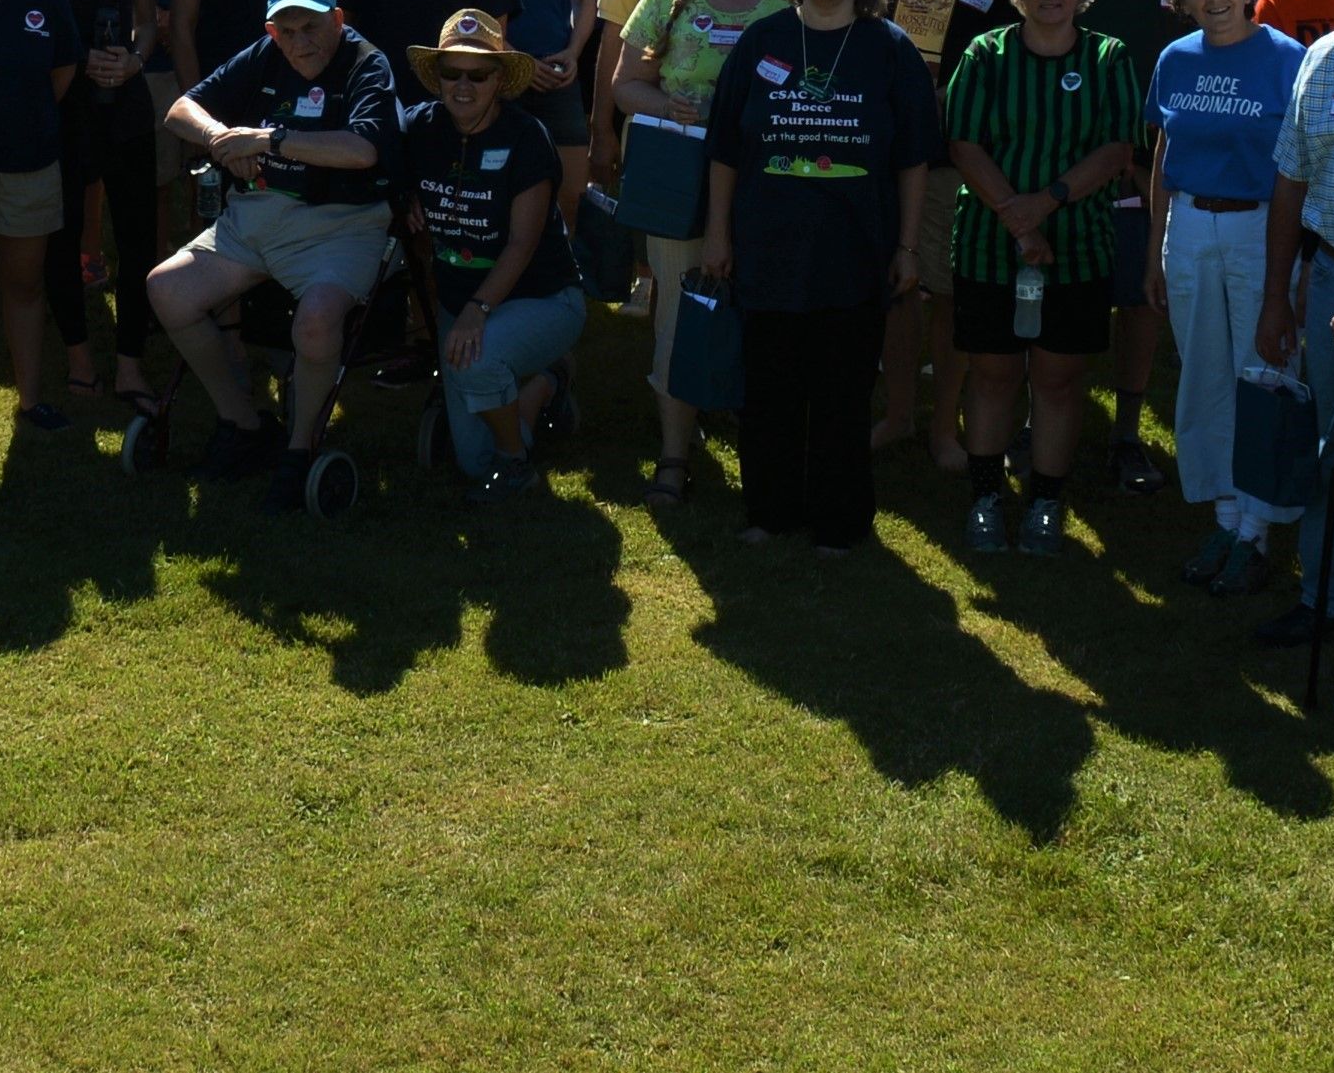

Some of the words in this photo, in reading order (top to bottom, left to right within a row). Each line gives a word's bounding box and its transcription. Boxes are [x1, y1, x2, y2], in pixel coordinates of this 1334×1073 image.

[1195, 74, 1241, 96] BOCCE
[768, 90, 808, 100] CSAC
[791, 102, 832, 112] Bocce
[1168, 92, 1264, 118] COORDINATOR
[770, 114, 860, 127] Tournament
[762, 133, 777, 142] Let
[780, 132, 796, 141] the
[798, 132, 820, 144] good
[824, 134, 849, 144] times
[420, 179, 454, 196] CSAC
